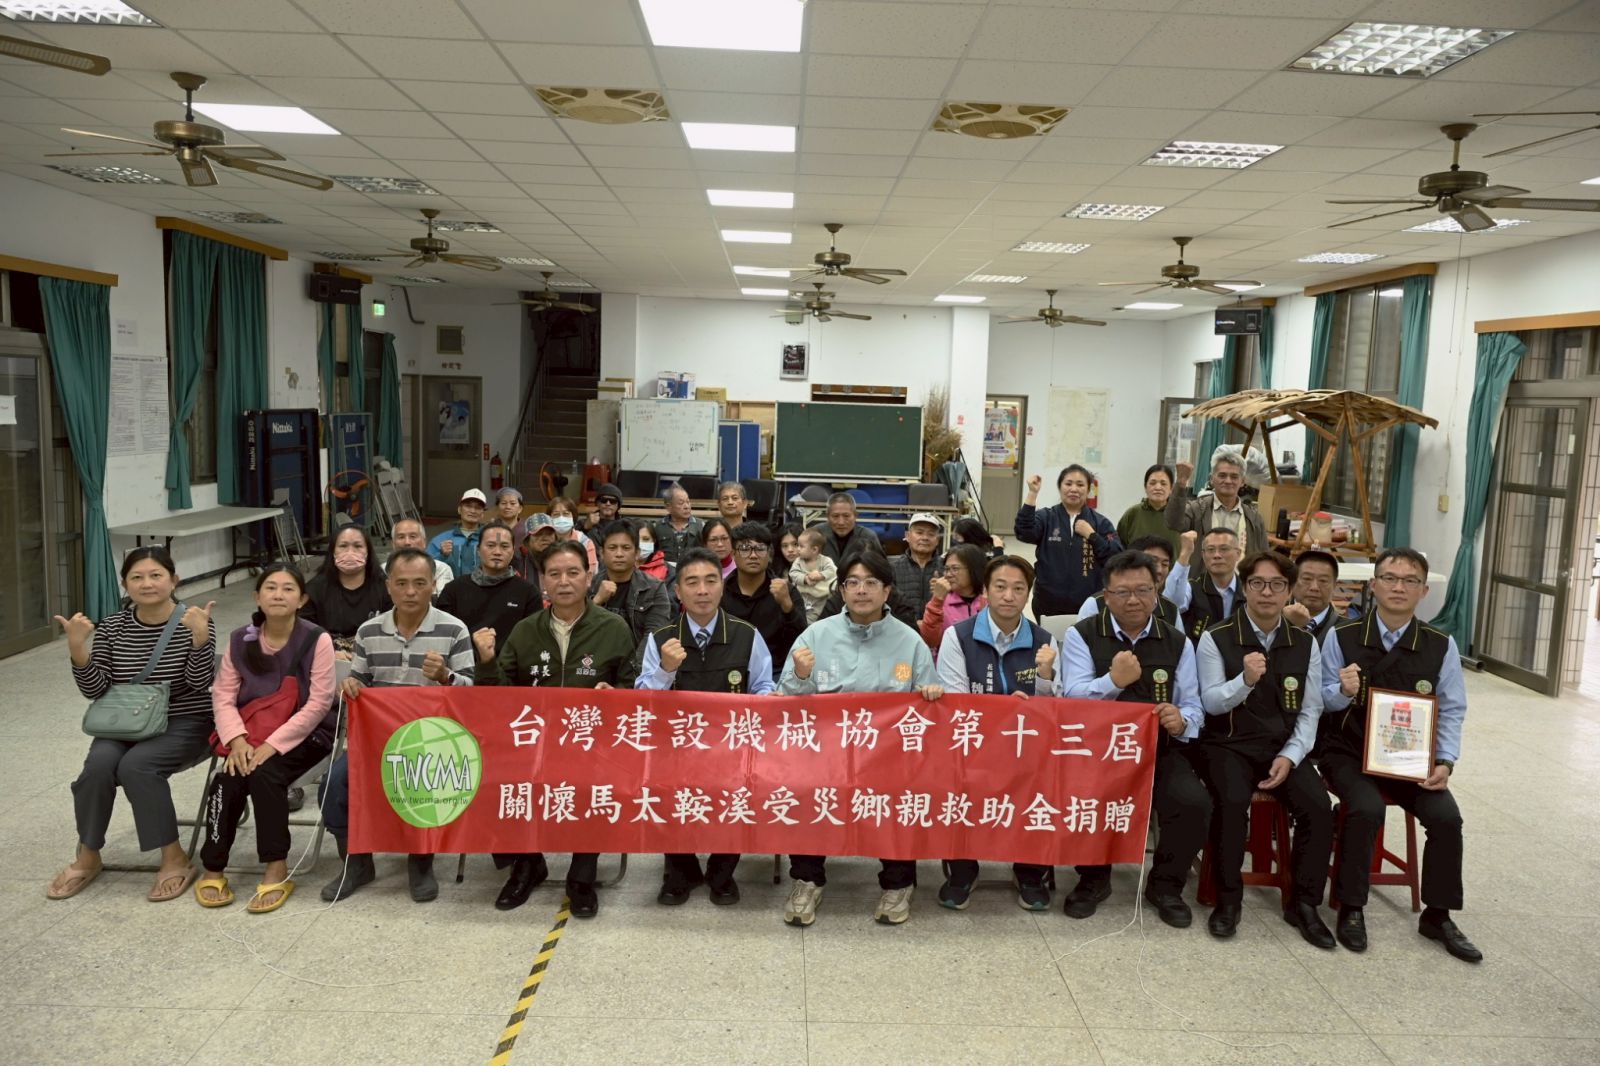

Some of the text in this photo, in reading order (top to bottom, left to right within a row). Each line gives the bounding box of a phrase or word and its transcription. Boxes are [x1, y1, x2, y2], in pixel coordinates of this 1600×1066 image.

[509, 704, 1142, 764] 台灣建設機械協會第十三屆
[386, 752, 472, 794] TWCMA
[498, 781, 1136, 834] 關懷馬太鞍溪受災鄉親救助金捐贈
